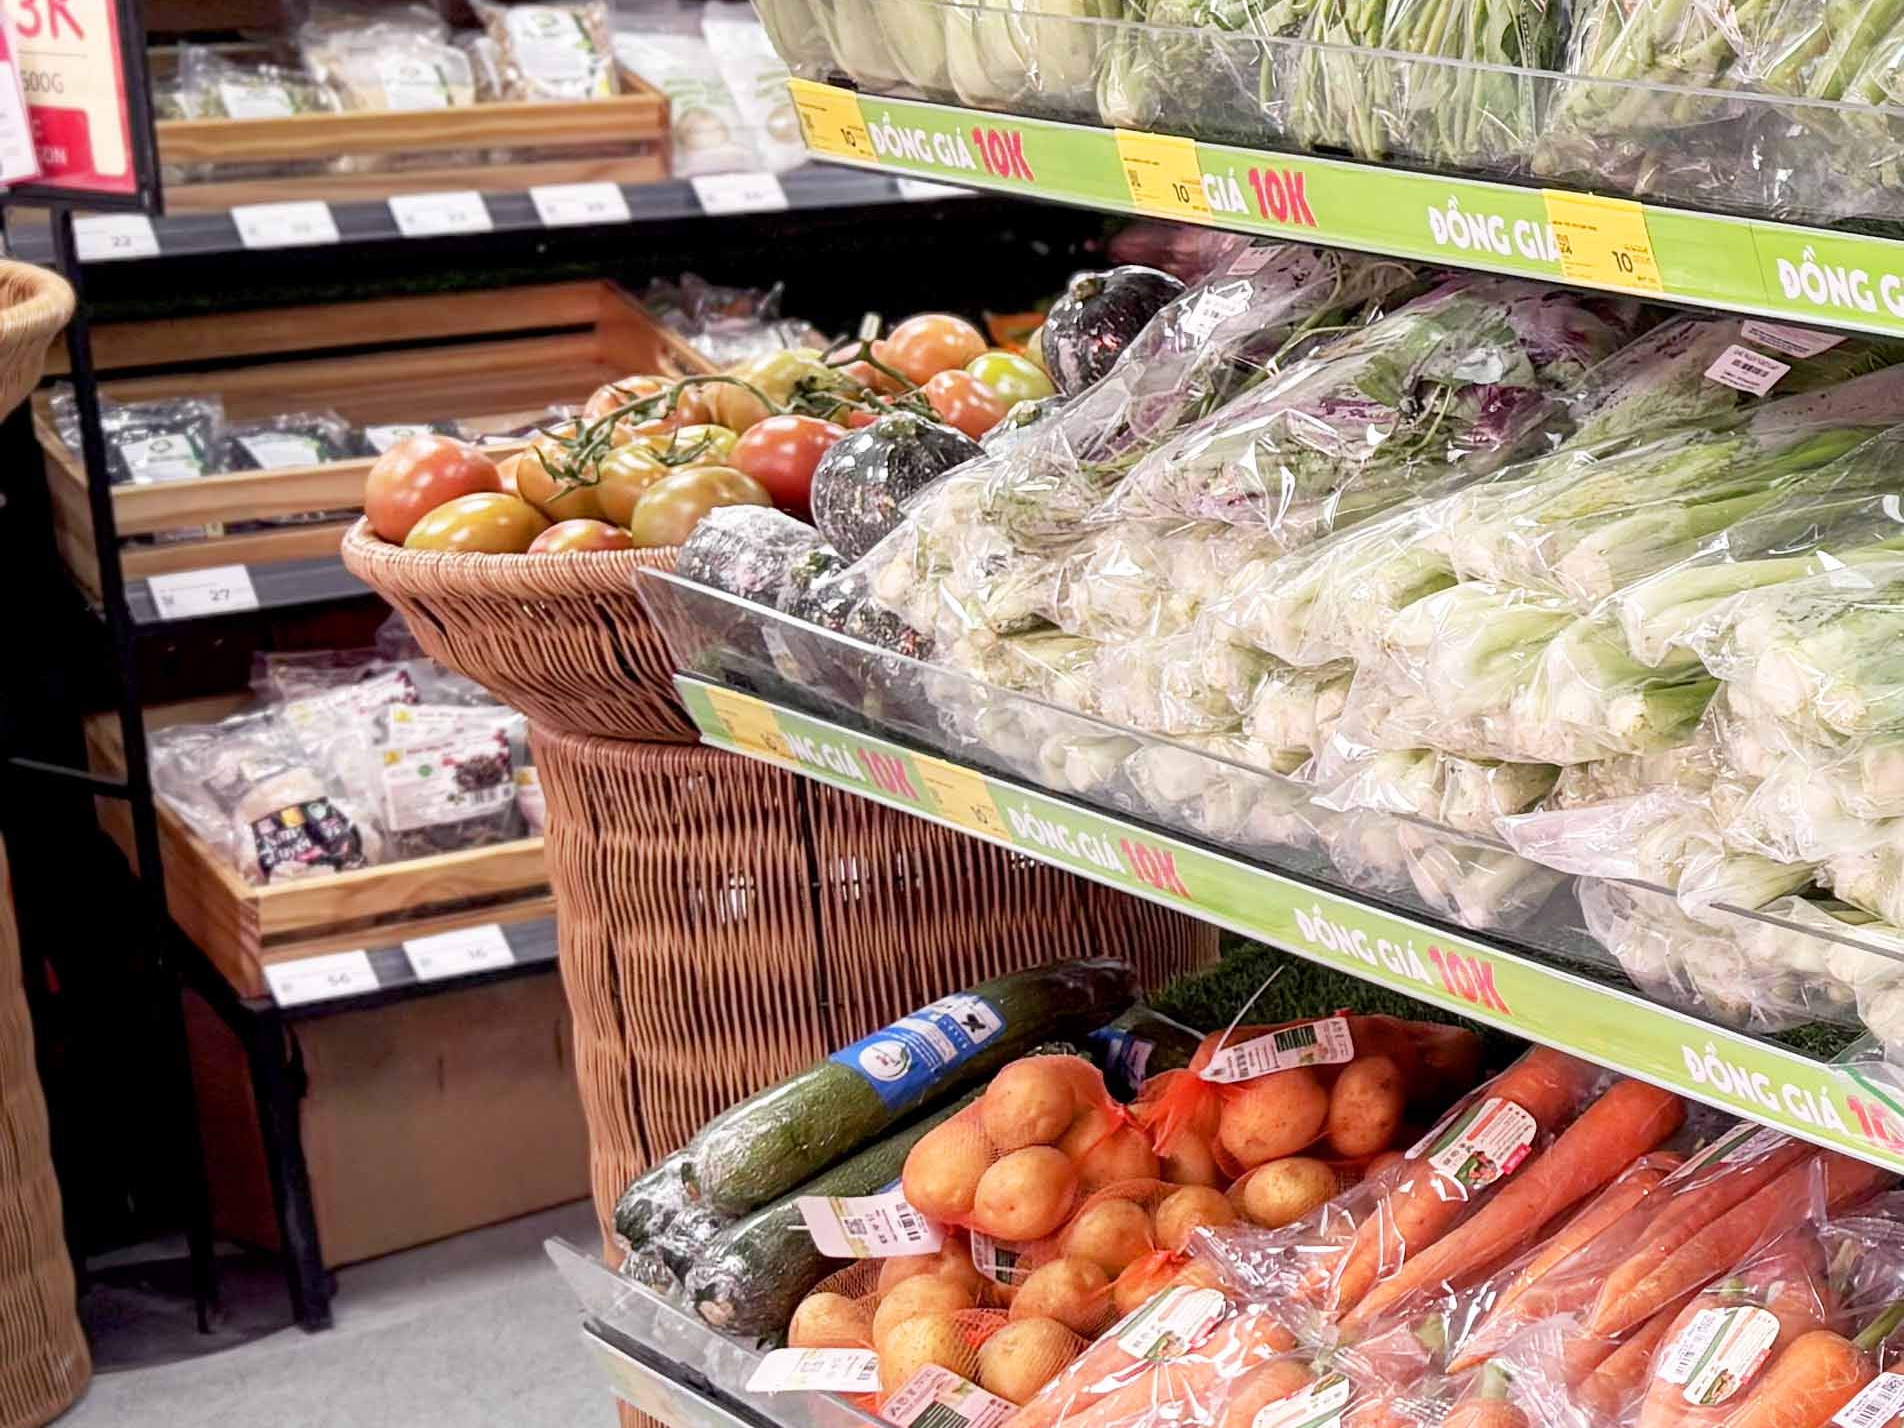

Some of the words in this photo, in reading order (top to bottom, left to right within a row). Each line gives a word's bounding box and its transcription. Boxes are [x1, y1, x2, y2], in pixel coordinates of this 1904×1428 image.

[841, 127, 856, 149] 10
[868, 108, 934, 165] ĐỒNG
[932, 124, 977, 171] GIÁ
[971, 126, 1036, 183] 10K
[1172, 183, 1190, 204] 10
[1204, 166, 1250, 215] GIÁ
[1248, 167, 1319, 229] 10K
[1428, 194, 1511, 256] ĐỒNG
[1611, 250, 1634, 275] 10
[1777, 244, 1879, 314] ĐỒNG
[857, 747, 921, 802] 10K
[1007, 798, 1079, 856] ĐỒNG
[1077, 825, 1127, 876] GIÁ
[1119, 837, 1193, 900] 10K
[1294, 903, 1376, 965] ĐỒNG
[1376, 930, 1435, 987] GIÁ
[1426, 944, 1512, 1015] 10K
[1681, 1042, 1780, 1113] ĐỒNG
[1782, 1072, 1846, 1135] GIÁ
